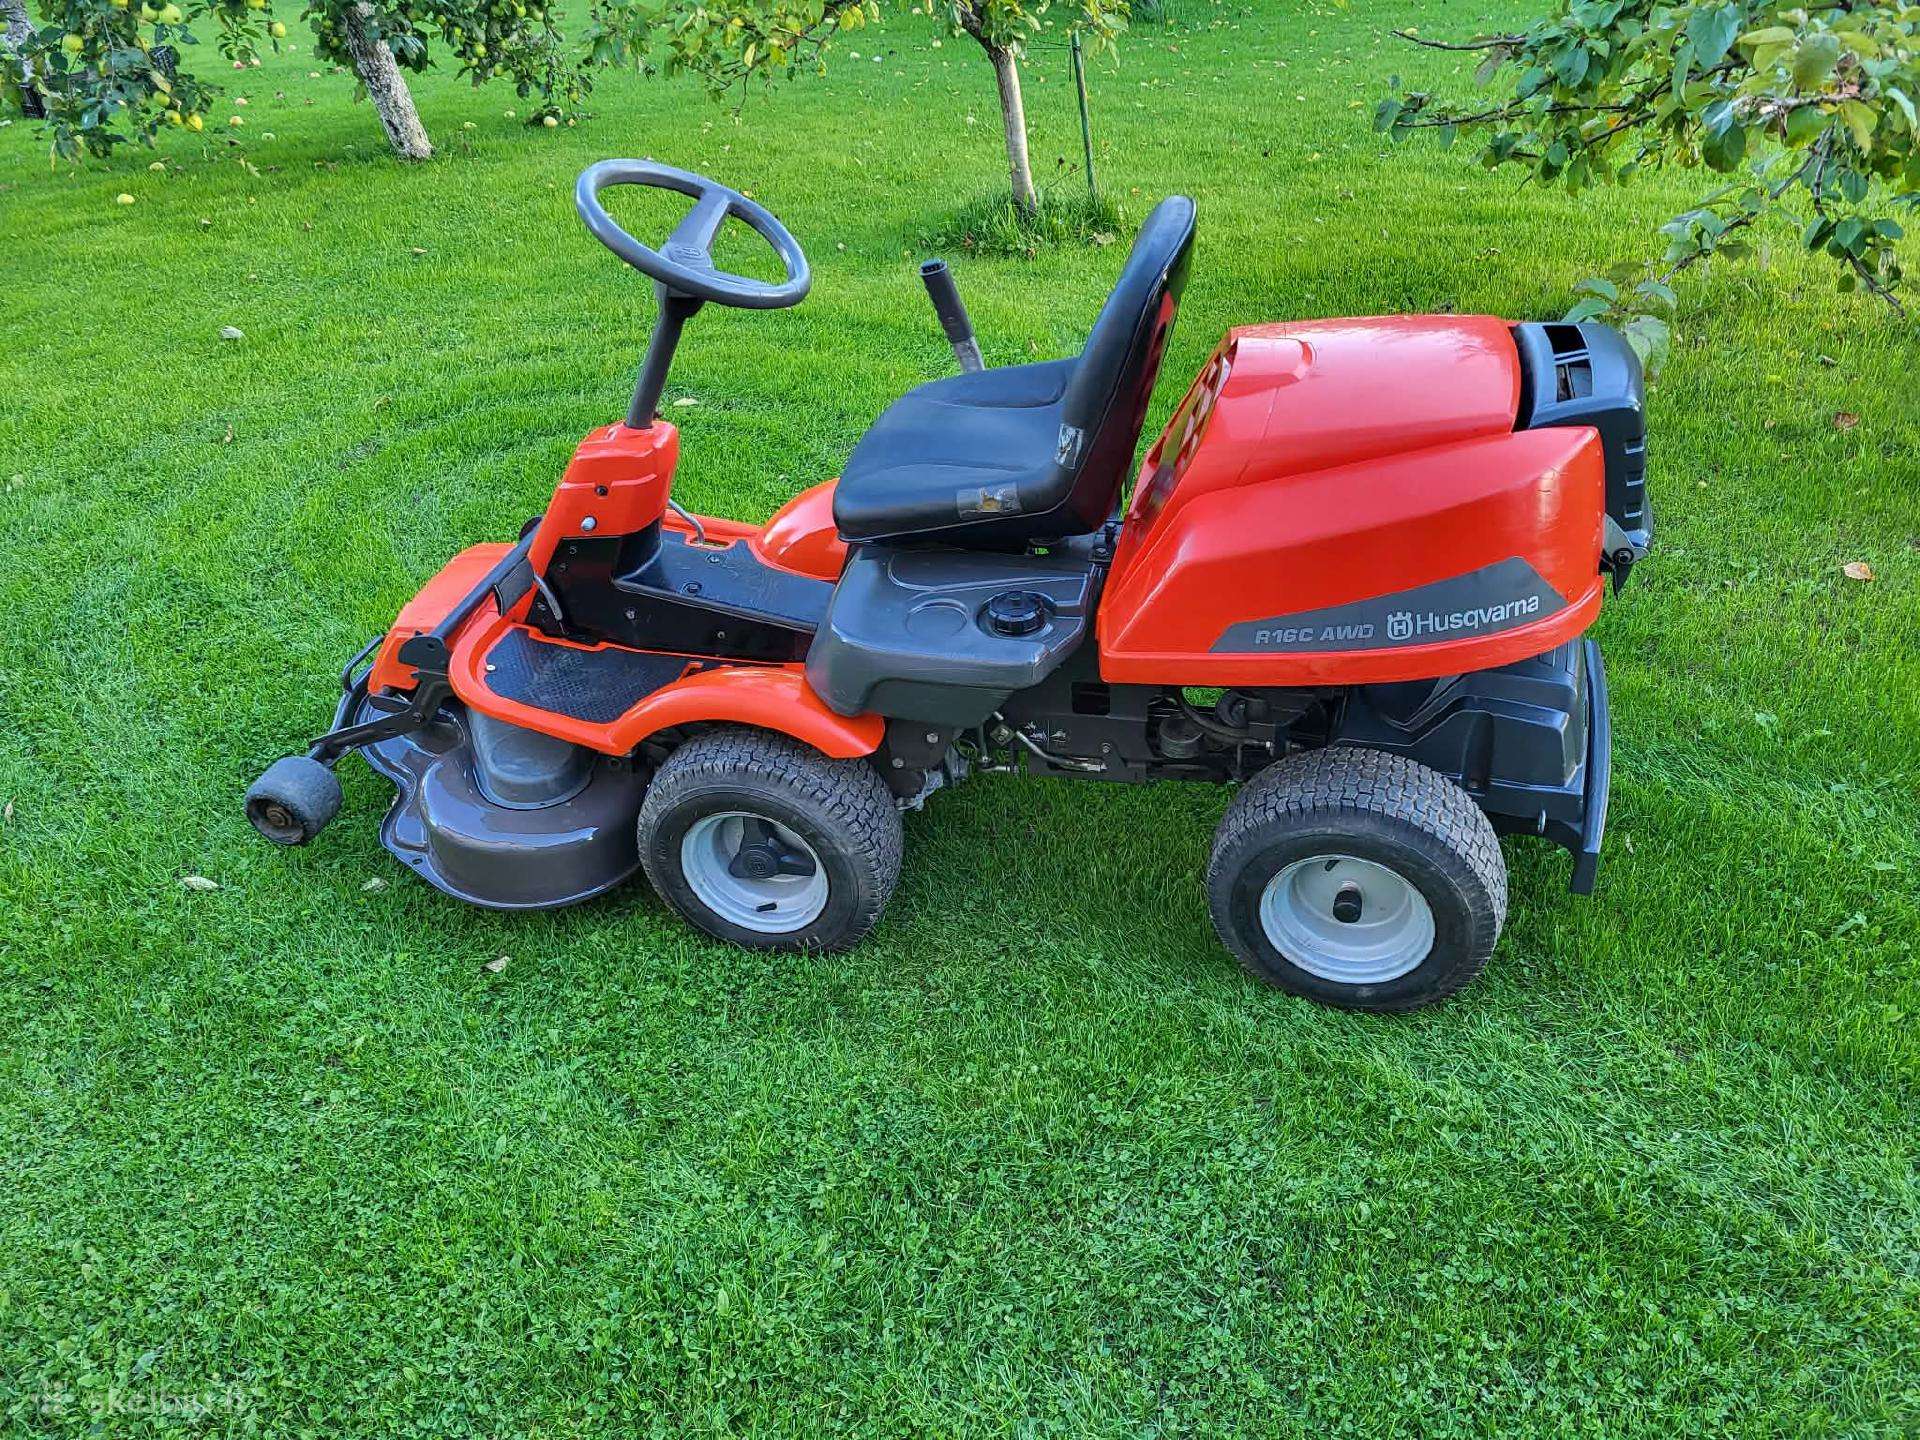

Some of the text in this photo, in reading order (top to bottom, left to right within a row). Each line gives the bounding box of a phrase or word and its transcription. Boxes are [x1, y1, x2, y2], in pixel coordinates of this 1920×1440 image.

[1416, 595, 1539, 635] Husqvarna
[1255, 623, 1375, 644] R16C AWD
